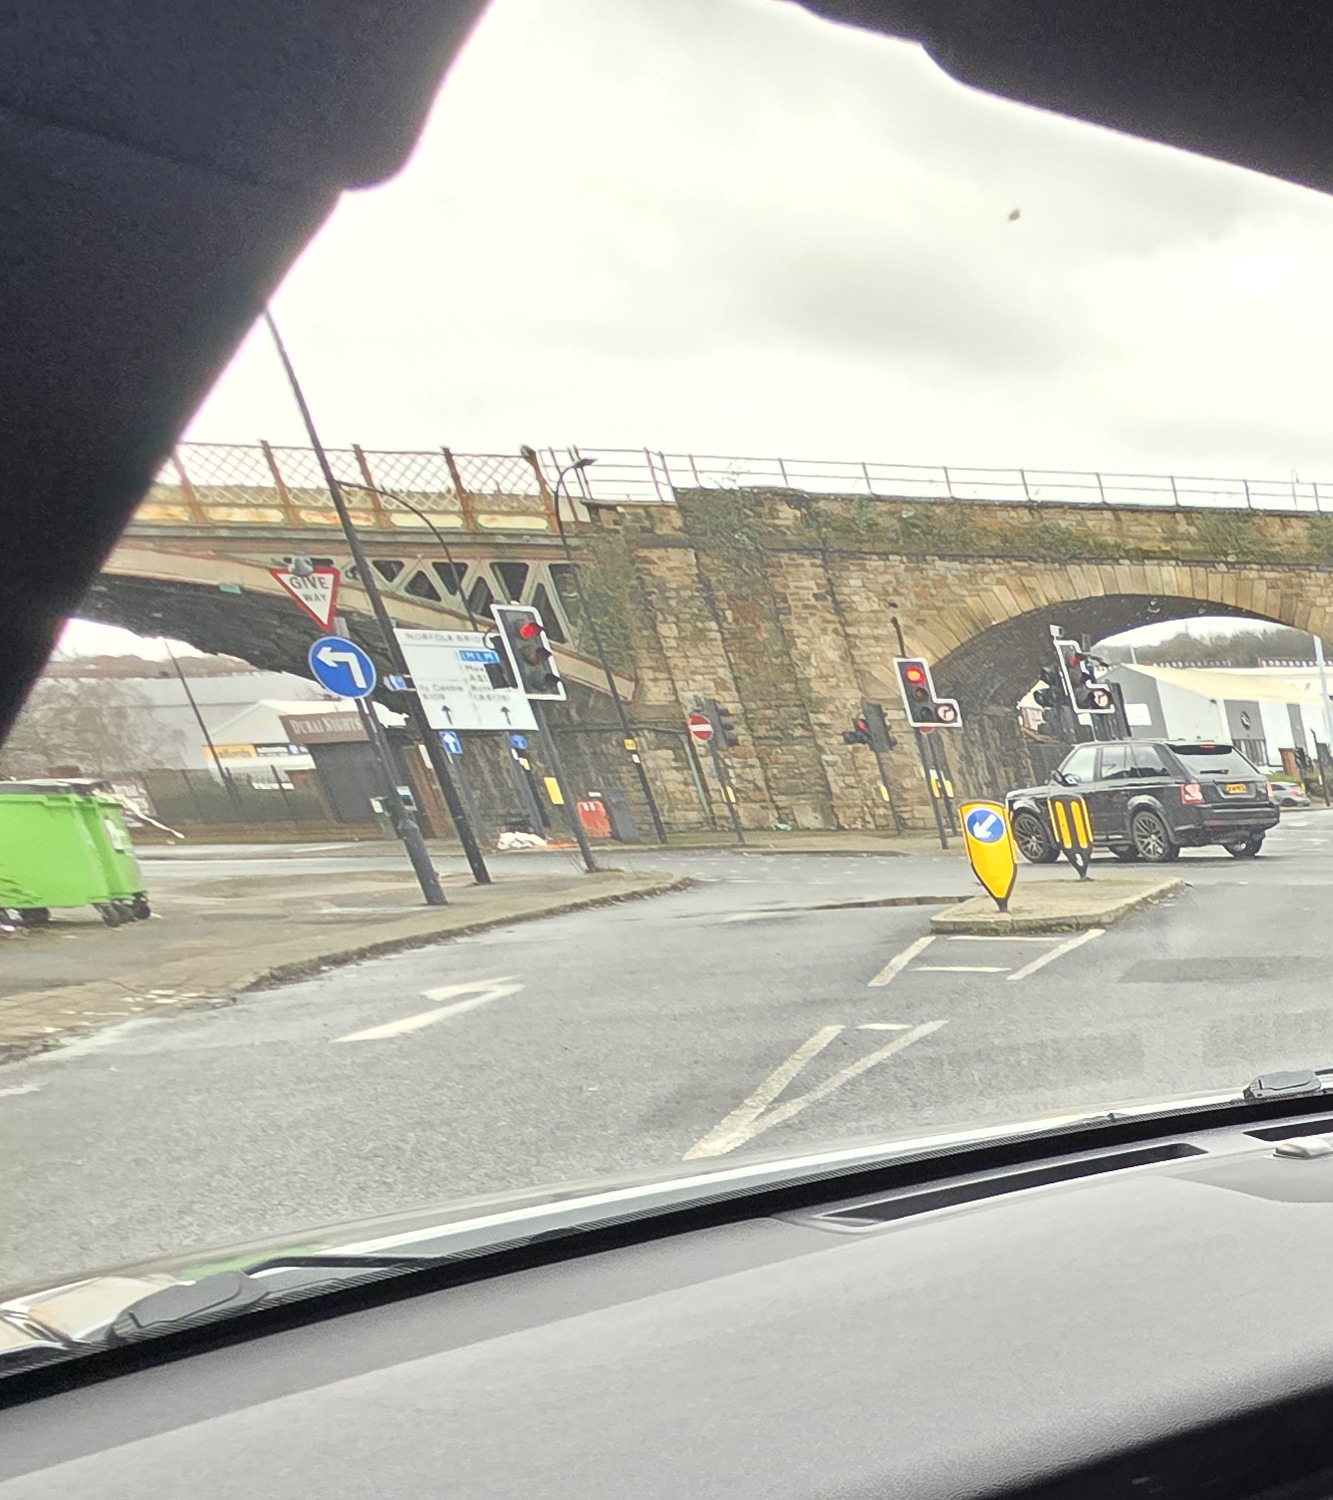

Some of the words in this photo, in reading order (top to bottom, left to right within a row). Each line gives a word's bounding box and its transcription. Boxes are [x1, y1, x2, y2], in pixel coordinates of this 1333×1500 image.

[289, 576, 330, 590] GIVE
[302, 593, 327, 602] WAY
[405, 633, 453, 641] NORFOLK
[456, 635, 481, 643] BRID
[321, 715, 364, 732] NIGHTS
